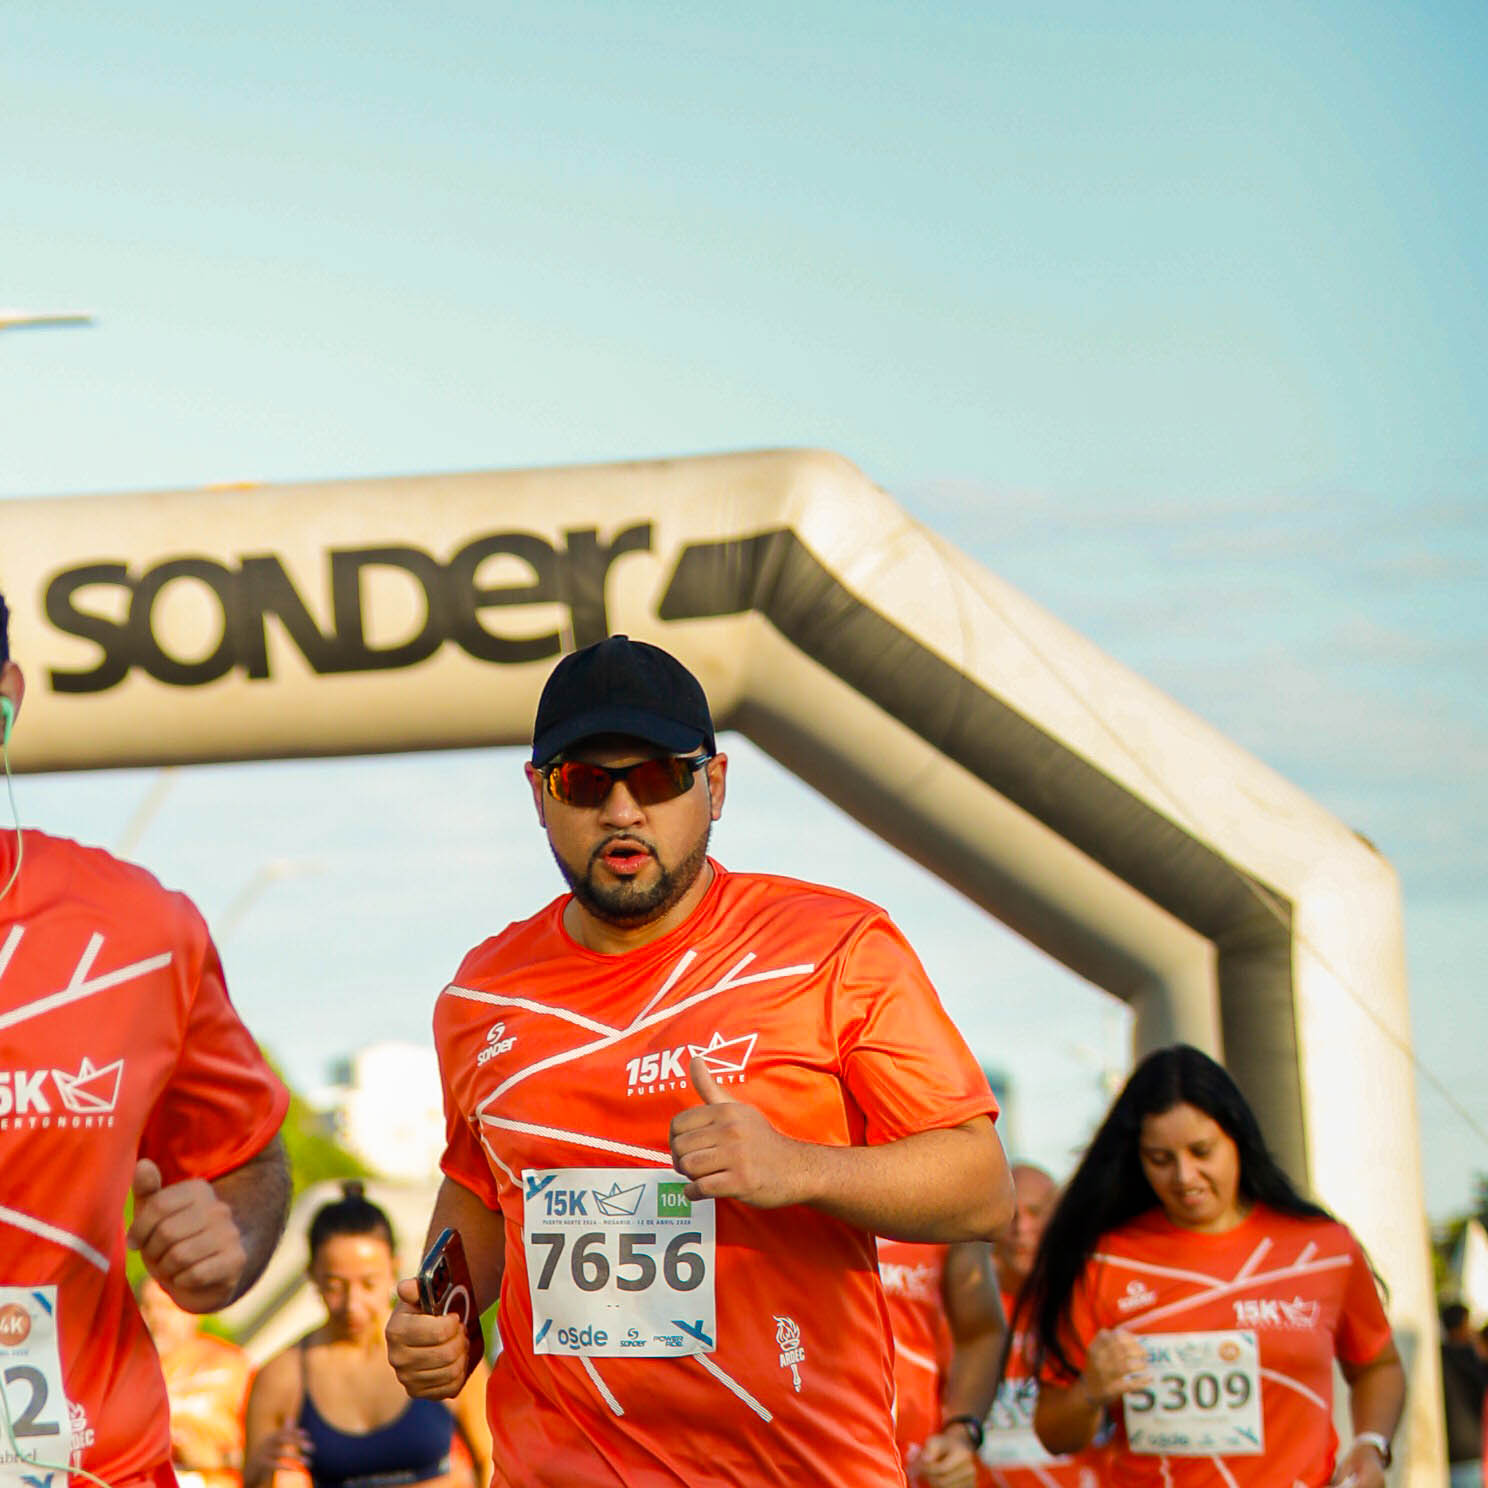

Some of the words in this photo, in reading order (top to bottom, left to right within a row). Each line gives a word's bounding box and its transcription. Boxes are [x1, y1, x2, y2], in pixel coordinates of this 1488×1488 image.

[625, 1045, 686, 1086] 15K
[627, 1081, 687, 1096] PUERTO
[544, 1190, 588, 1216] 15K
[660, 1193, 689, 1208] 10K
[530, 1231, 706, 1292] 7656
[557, 1324, 609, 1349] osde
[1129, 1370, 1252, 1413] 5309
